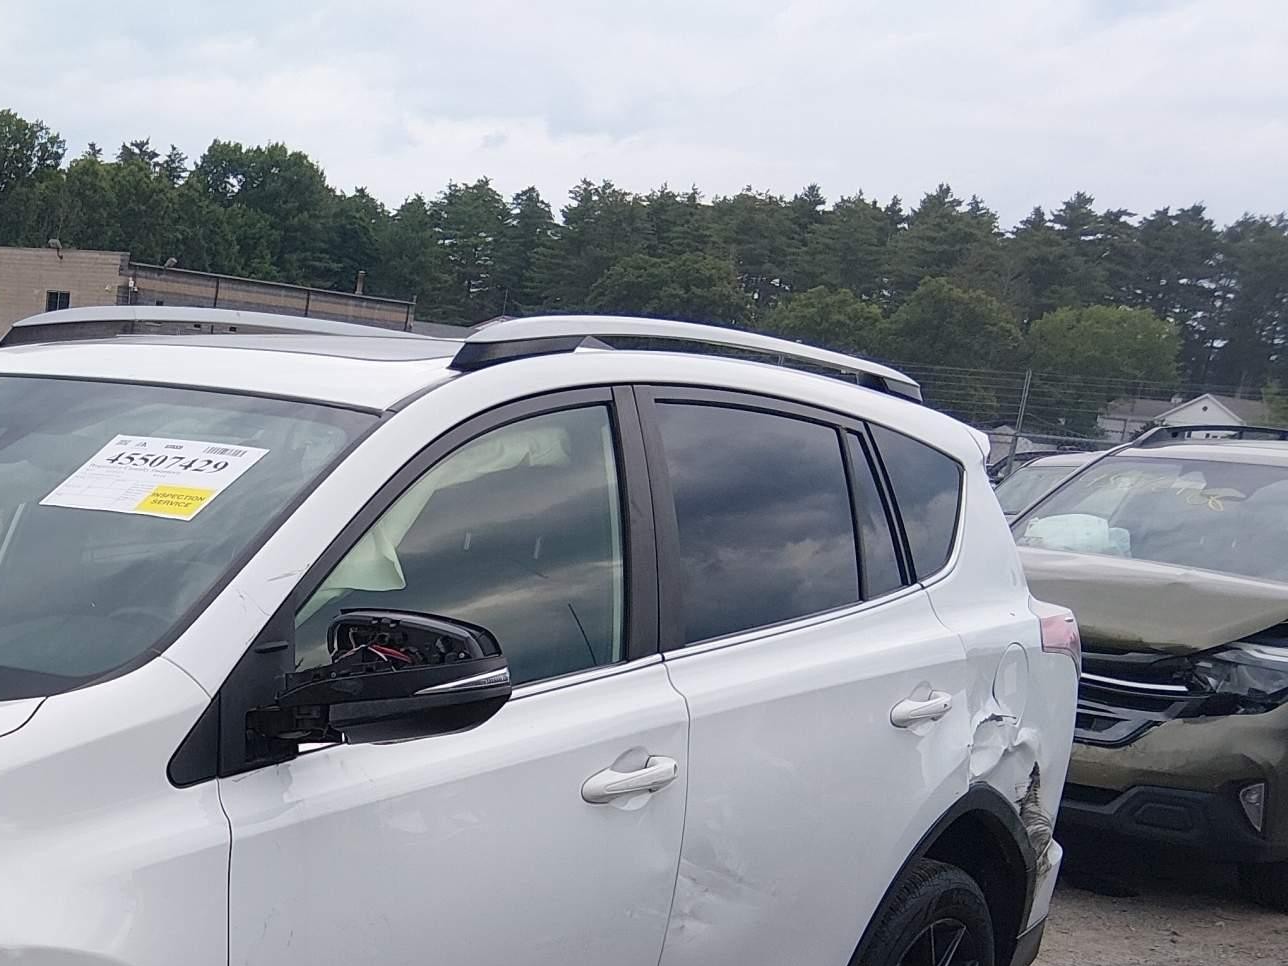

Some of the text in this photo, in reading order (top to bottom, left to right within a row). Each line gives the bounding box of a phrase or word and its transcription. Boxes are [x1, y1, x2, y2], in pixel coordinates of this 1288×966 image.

[106, 451, 229, 473] 45507429
[151, 492, 206, 502] INSPECTION
[150, 499, 192, 508] SERVICE
